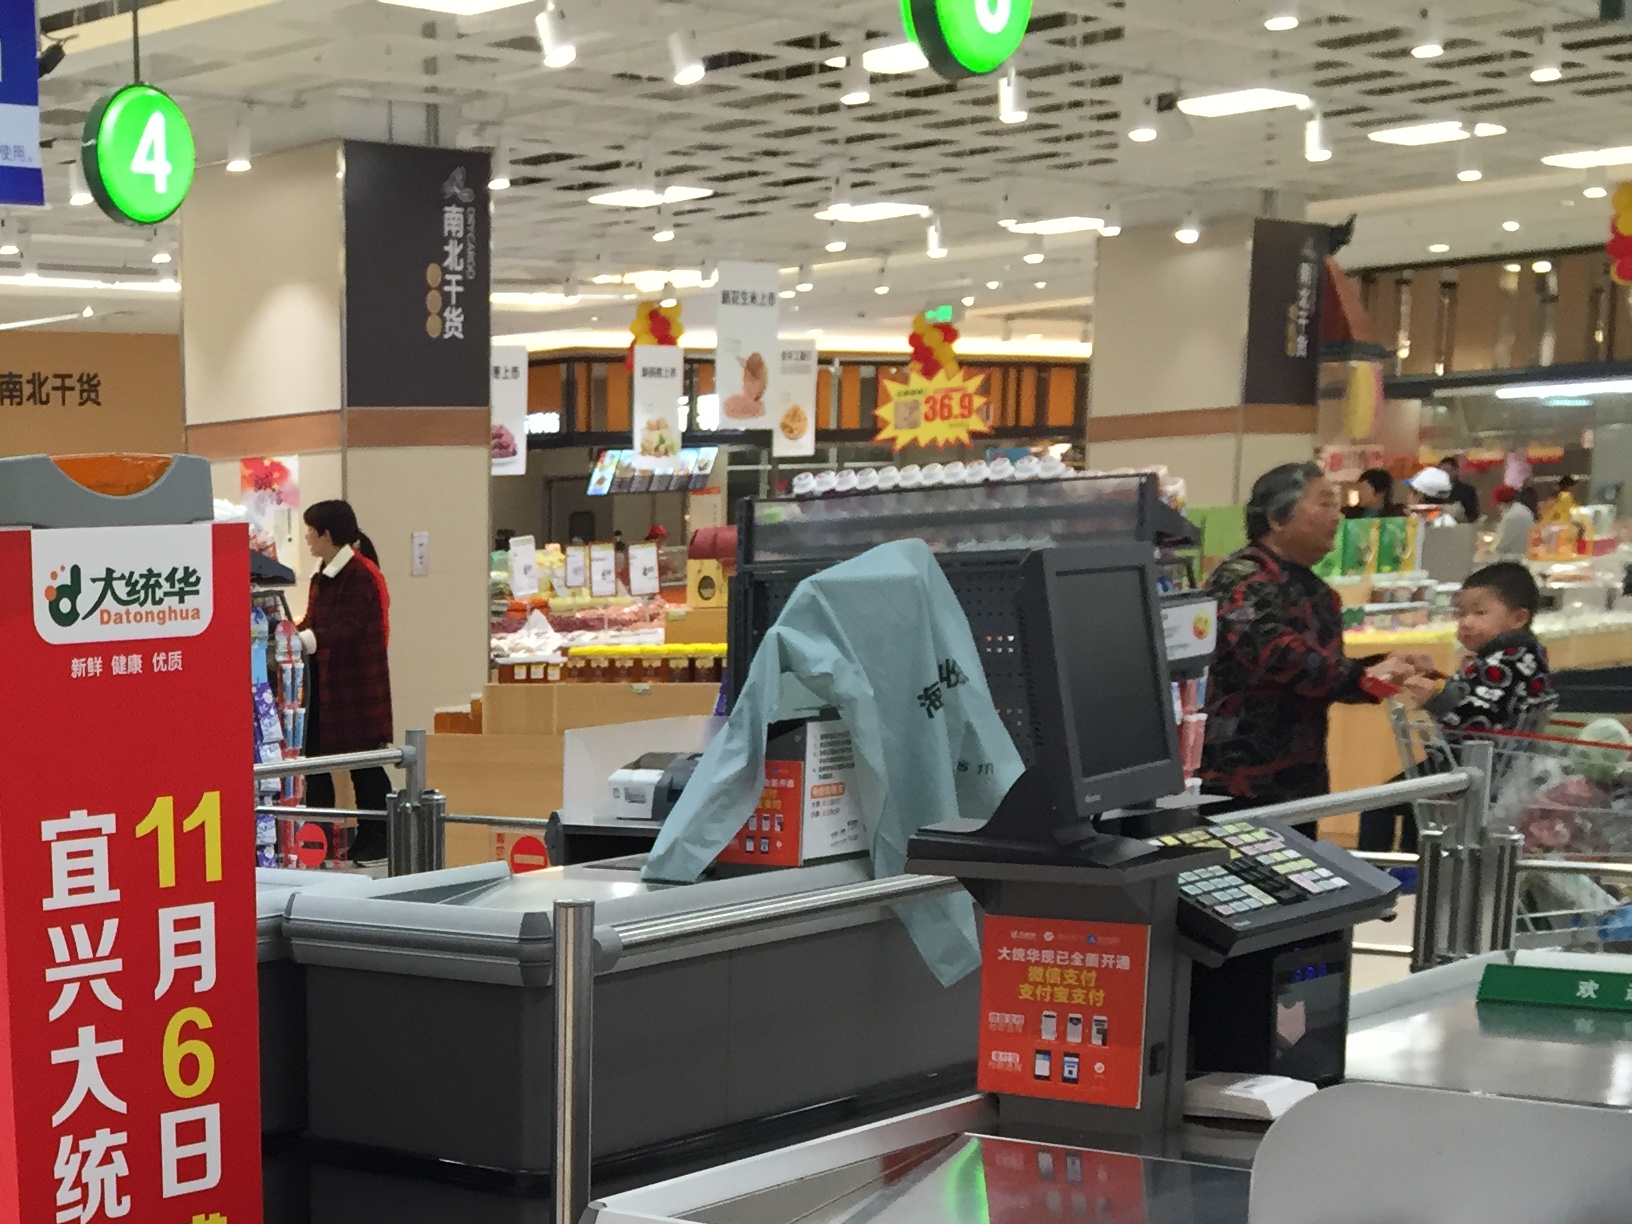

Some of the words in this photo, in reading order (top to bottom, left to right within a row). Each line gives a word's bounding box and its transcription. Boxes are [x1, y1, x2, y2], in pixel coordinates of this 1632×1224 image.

[131, 110, 172, 194] 4
[443, 204, 465, 339] 南北干货
[81, 566, 202, 621] 大统华
[99, 606, 201, 626] Datonghua
[70, 656, 104, 679] 新鲜
[111, 654, 143, 676] 健康
[152, 651, 183, 672] 优质
